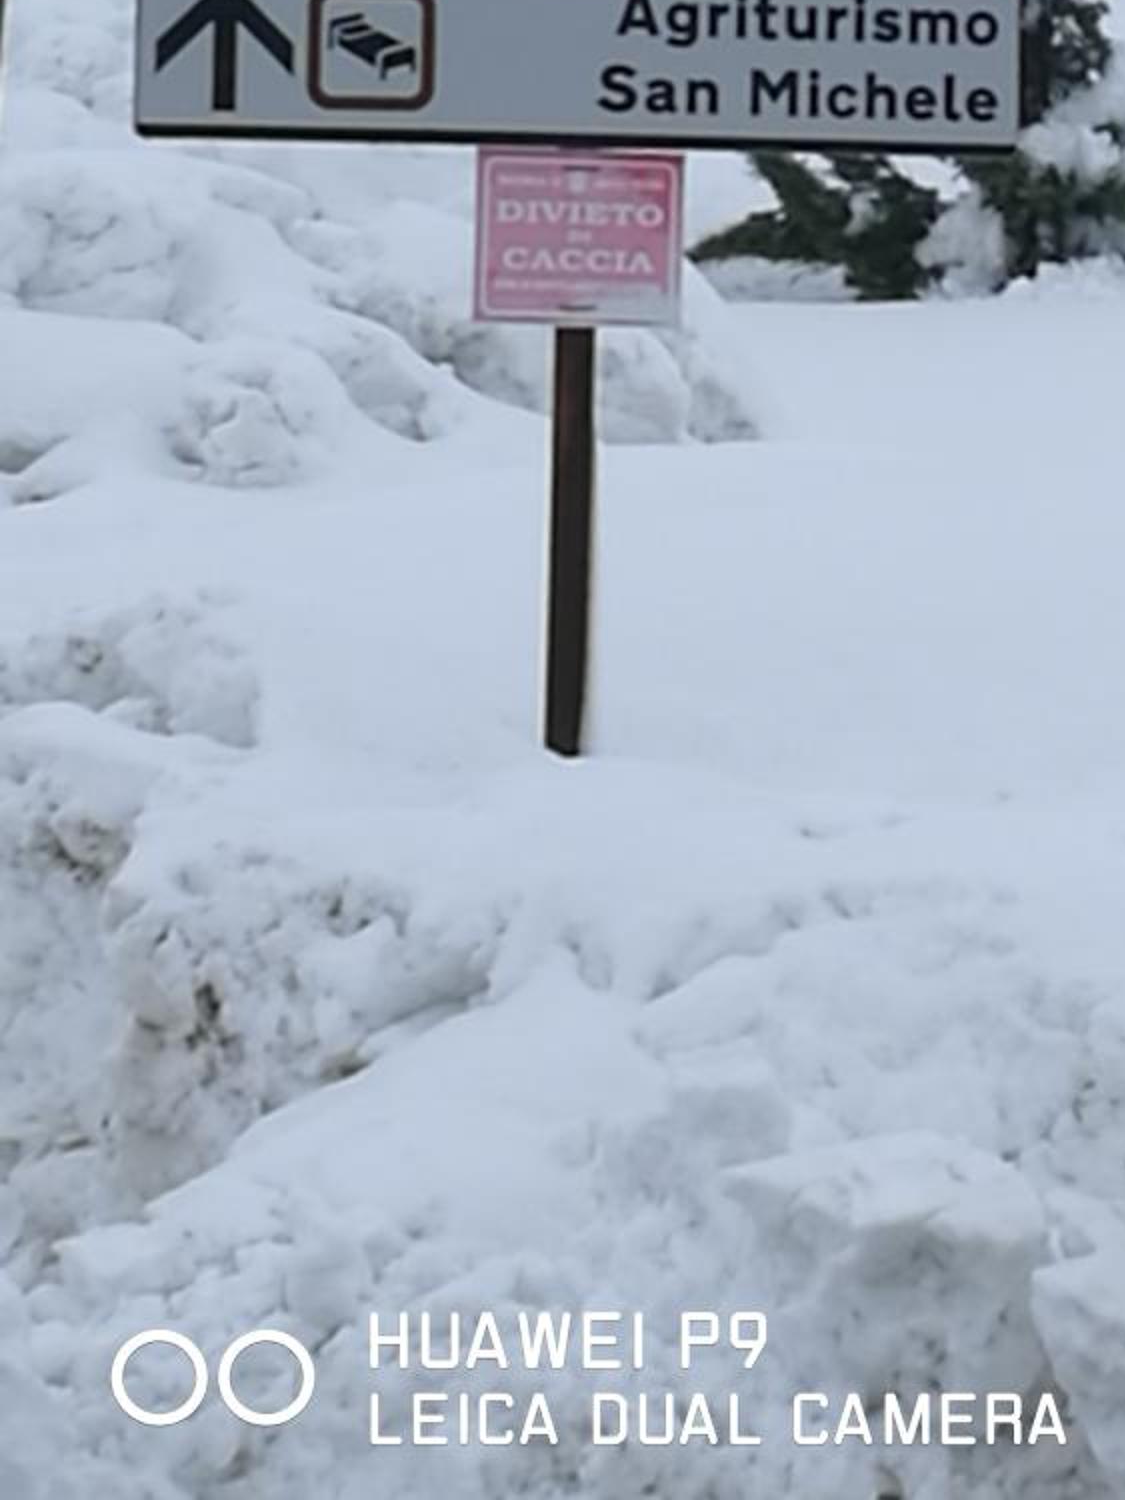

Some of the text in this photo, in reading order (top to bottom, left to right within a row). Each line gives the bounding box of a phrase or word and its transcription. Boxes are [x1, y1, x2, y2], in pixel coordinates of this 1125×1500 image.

[598, 66, 998, 122] San Michele
[497, 199, 665, 228] DIVIETO
[502, 247, 654, 274] CACCIA
